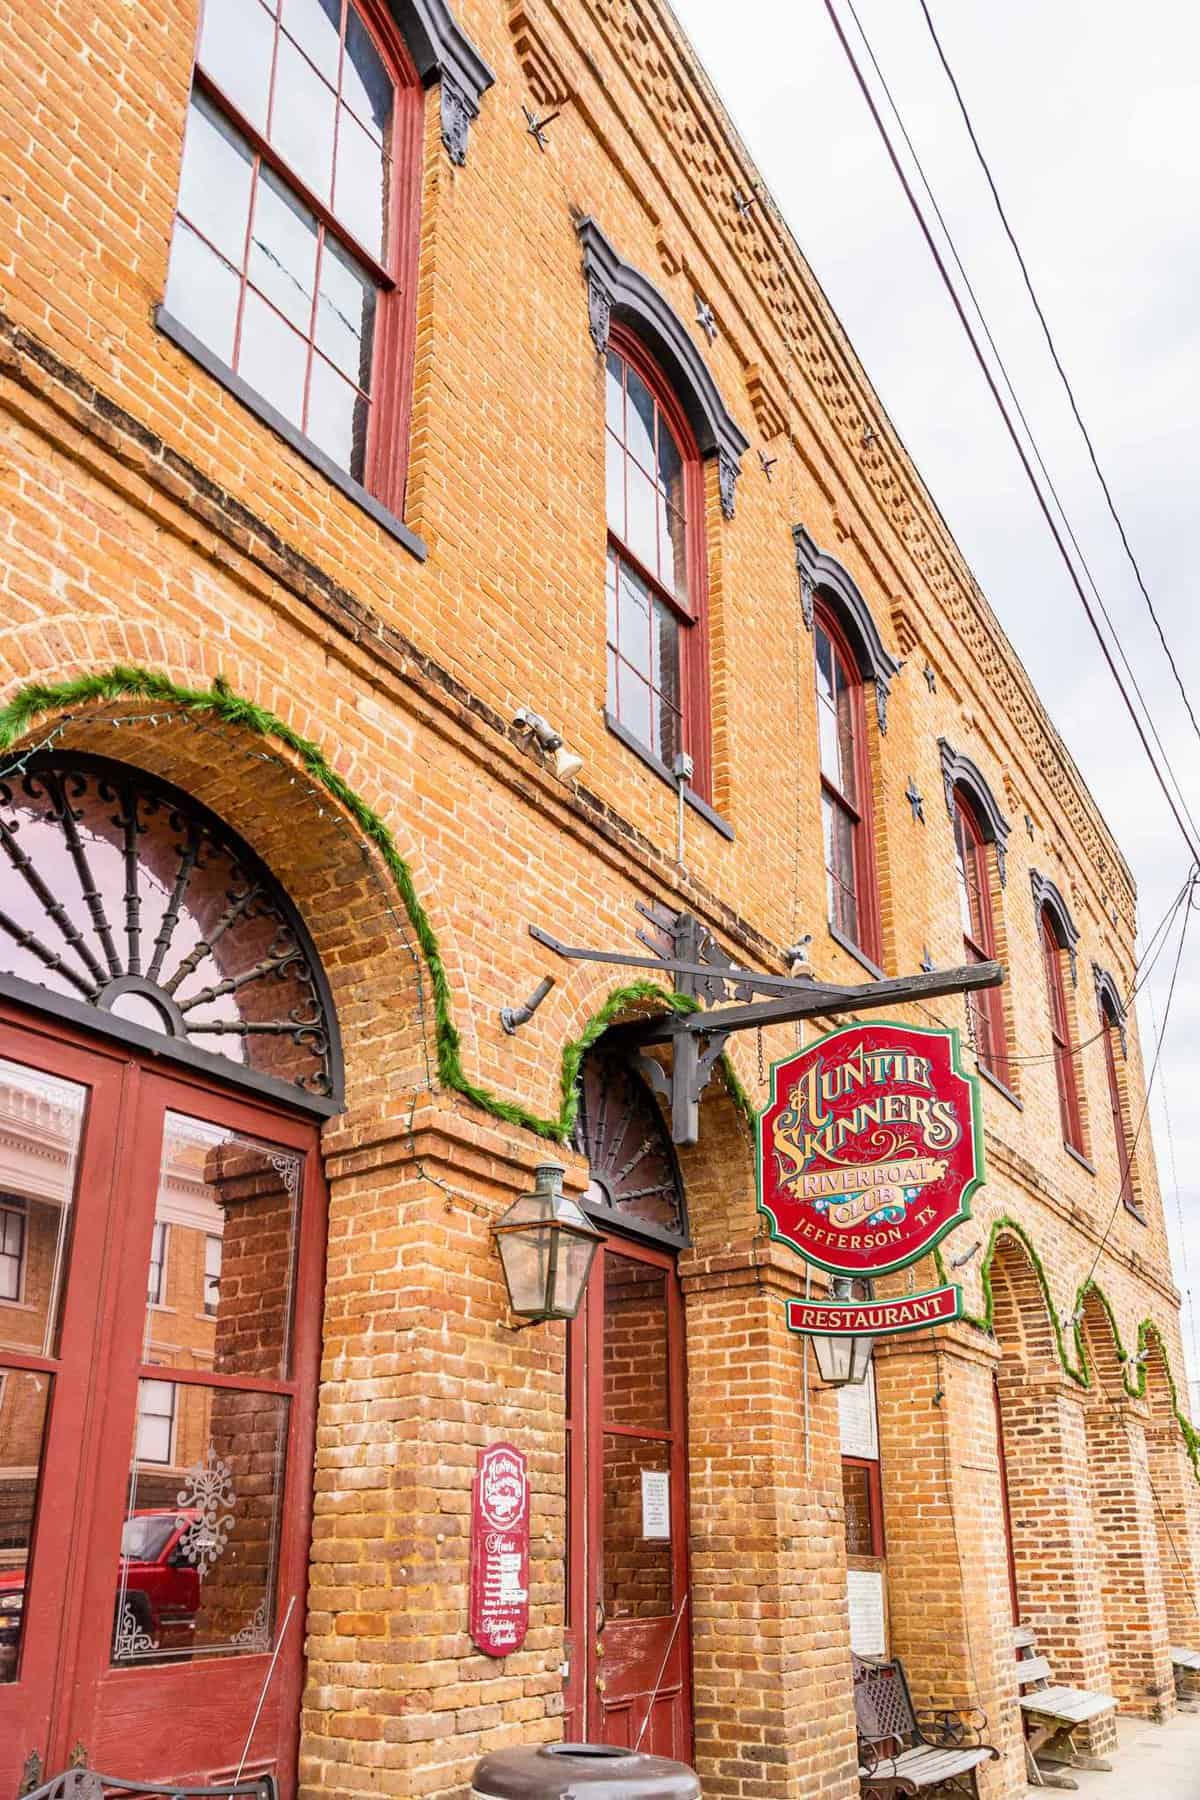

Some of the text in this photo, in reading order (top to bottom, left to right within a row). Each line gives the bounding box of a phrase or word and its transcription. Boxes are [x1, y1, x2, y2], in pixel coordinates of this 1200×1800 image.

[774, 1042, 932, 1129] AUNTIE
[774, 1096, 960, 1184] SKINNER'S
[803, 1163, 930, 1196] RIVERBOAT
[834, 1188, 897, 1223] CLUB
[793, 1205, 937, 1249] JEFFERSON, TX
[801, 1297, 943, 1328] RESTAURANT
